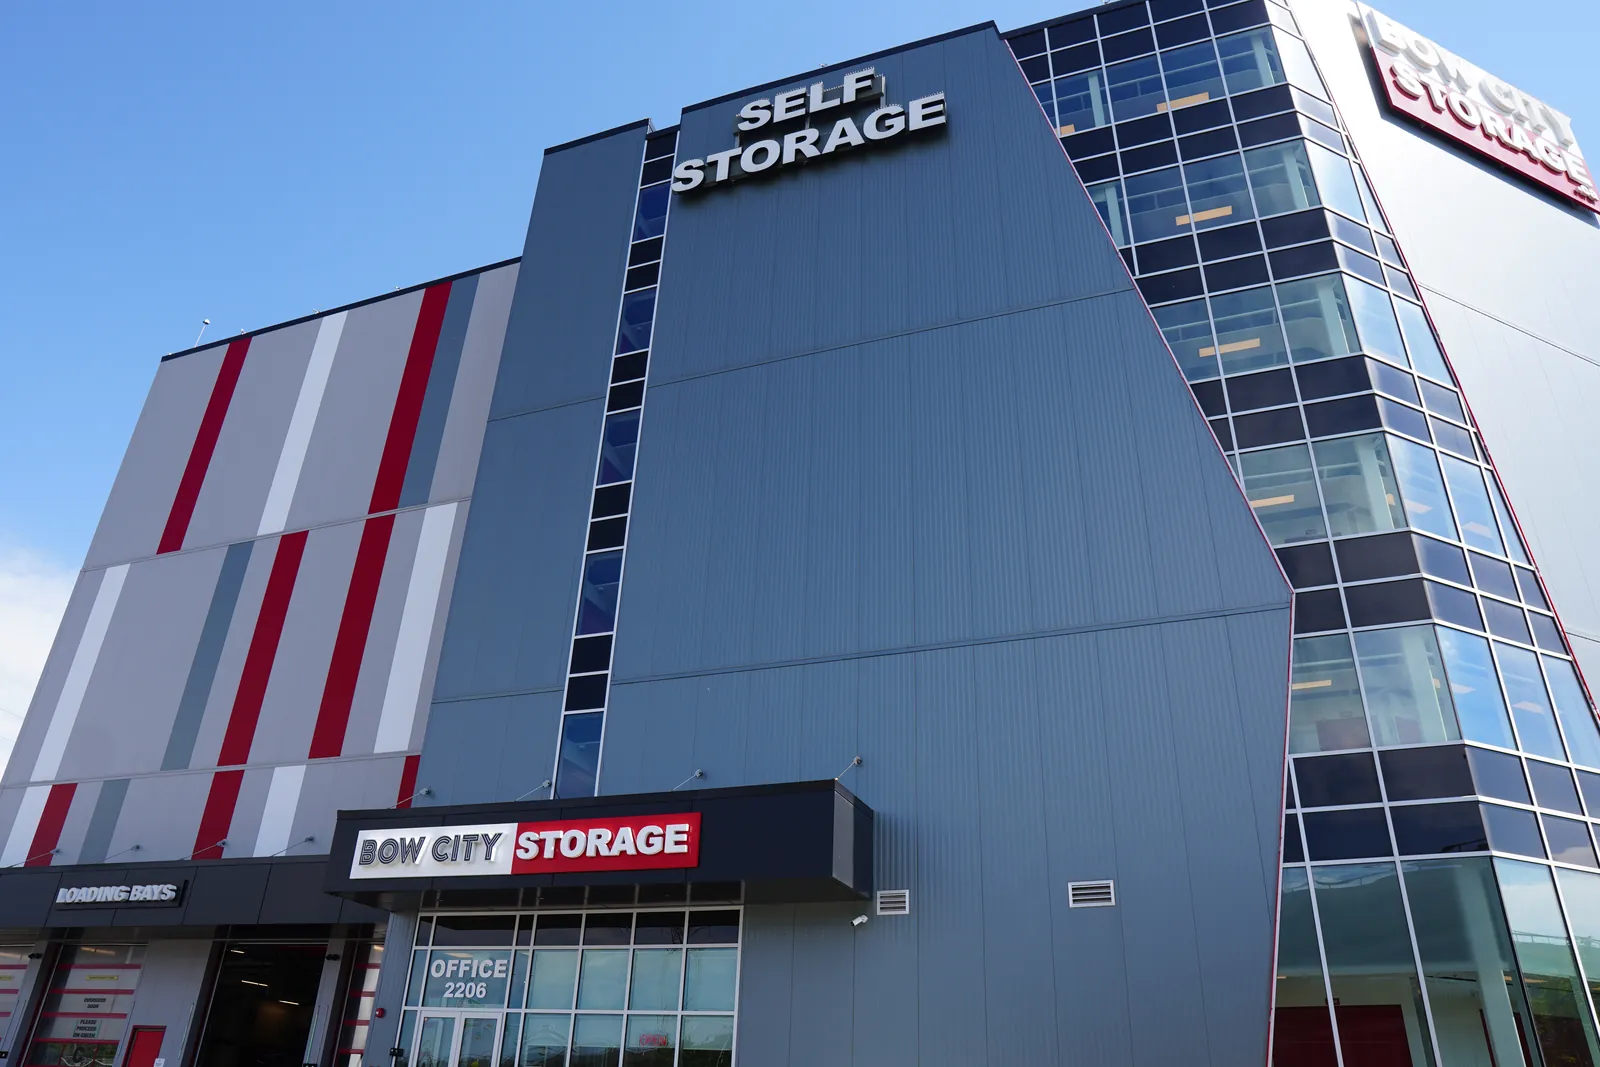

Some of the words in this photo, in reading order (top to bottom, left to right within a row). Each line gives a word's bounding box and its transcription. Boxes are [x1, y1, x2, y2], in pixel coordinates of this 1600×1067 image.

[737, 67, 876, 131] SELF
[1389, 60, 1594, 190] STORAGE
[1478, 77, 1573, 149] CITY
[671, 92, 947, 192] STORAGE
[358, 836, 427, 865] BOW
[431, 832, 503, 862] CITY
[515, 823, 691, 860] STORAGE
[56, 886, 130, 903] LOADING
[129, 884, 177, 901] BAYS
[430, 959, 508, 978] OFFICE
[443, 982, 488, 999] 2206
